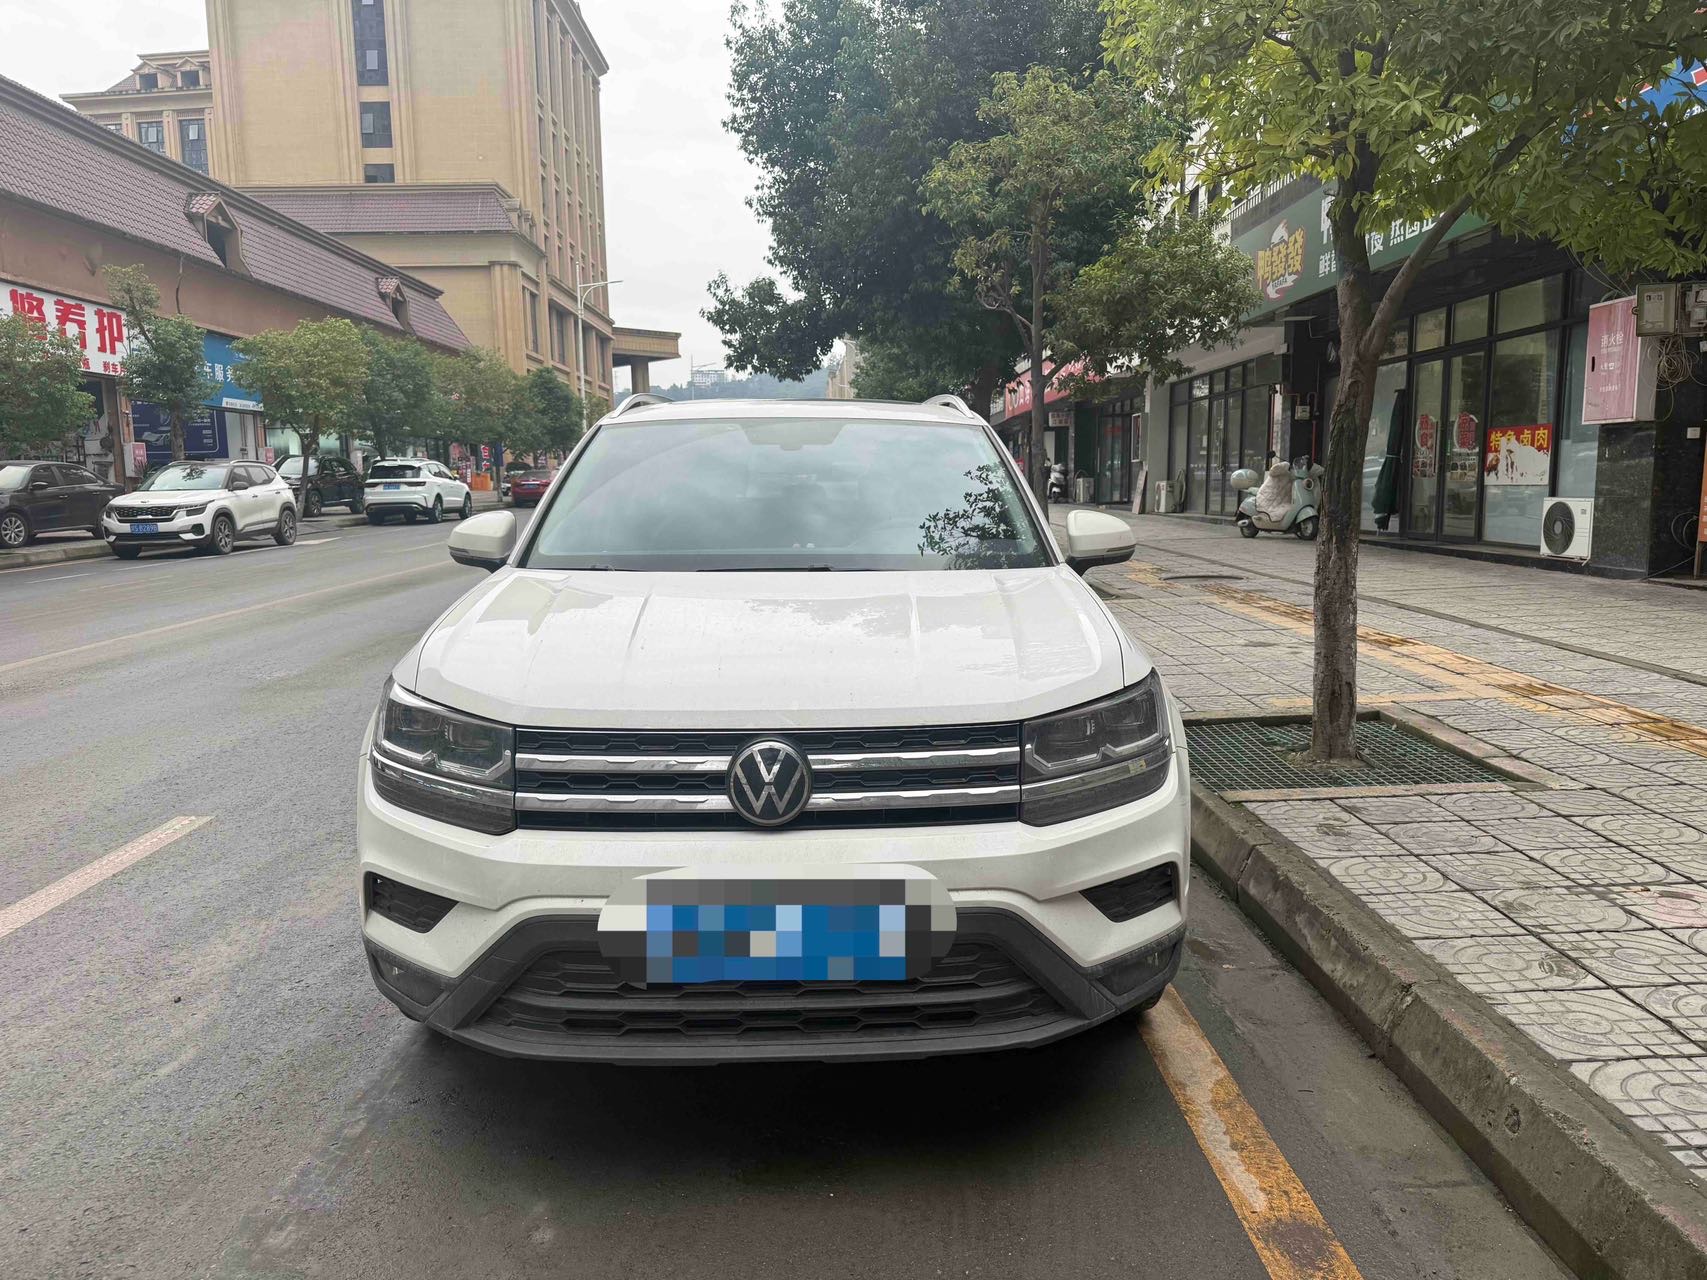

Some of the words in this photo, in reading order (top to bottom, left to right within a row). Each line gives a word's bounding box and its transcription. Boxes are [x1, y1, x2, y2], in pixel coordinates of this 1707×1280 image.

[1600, 331, 1624, 348] 消火栓
[195, 361, 234, 383] 车服务
